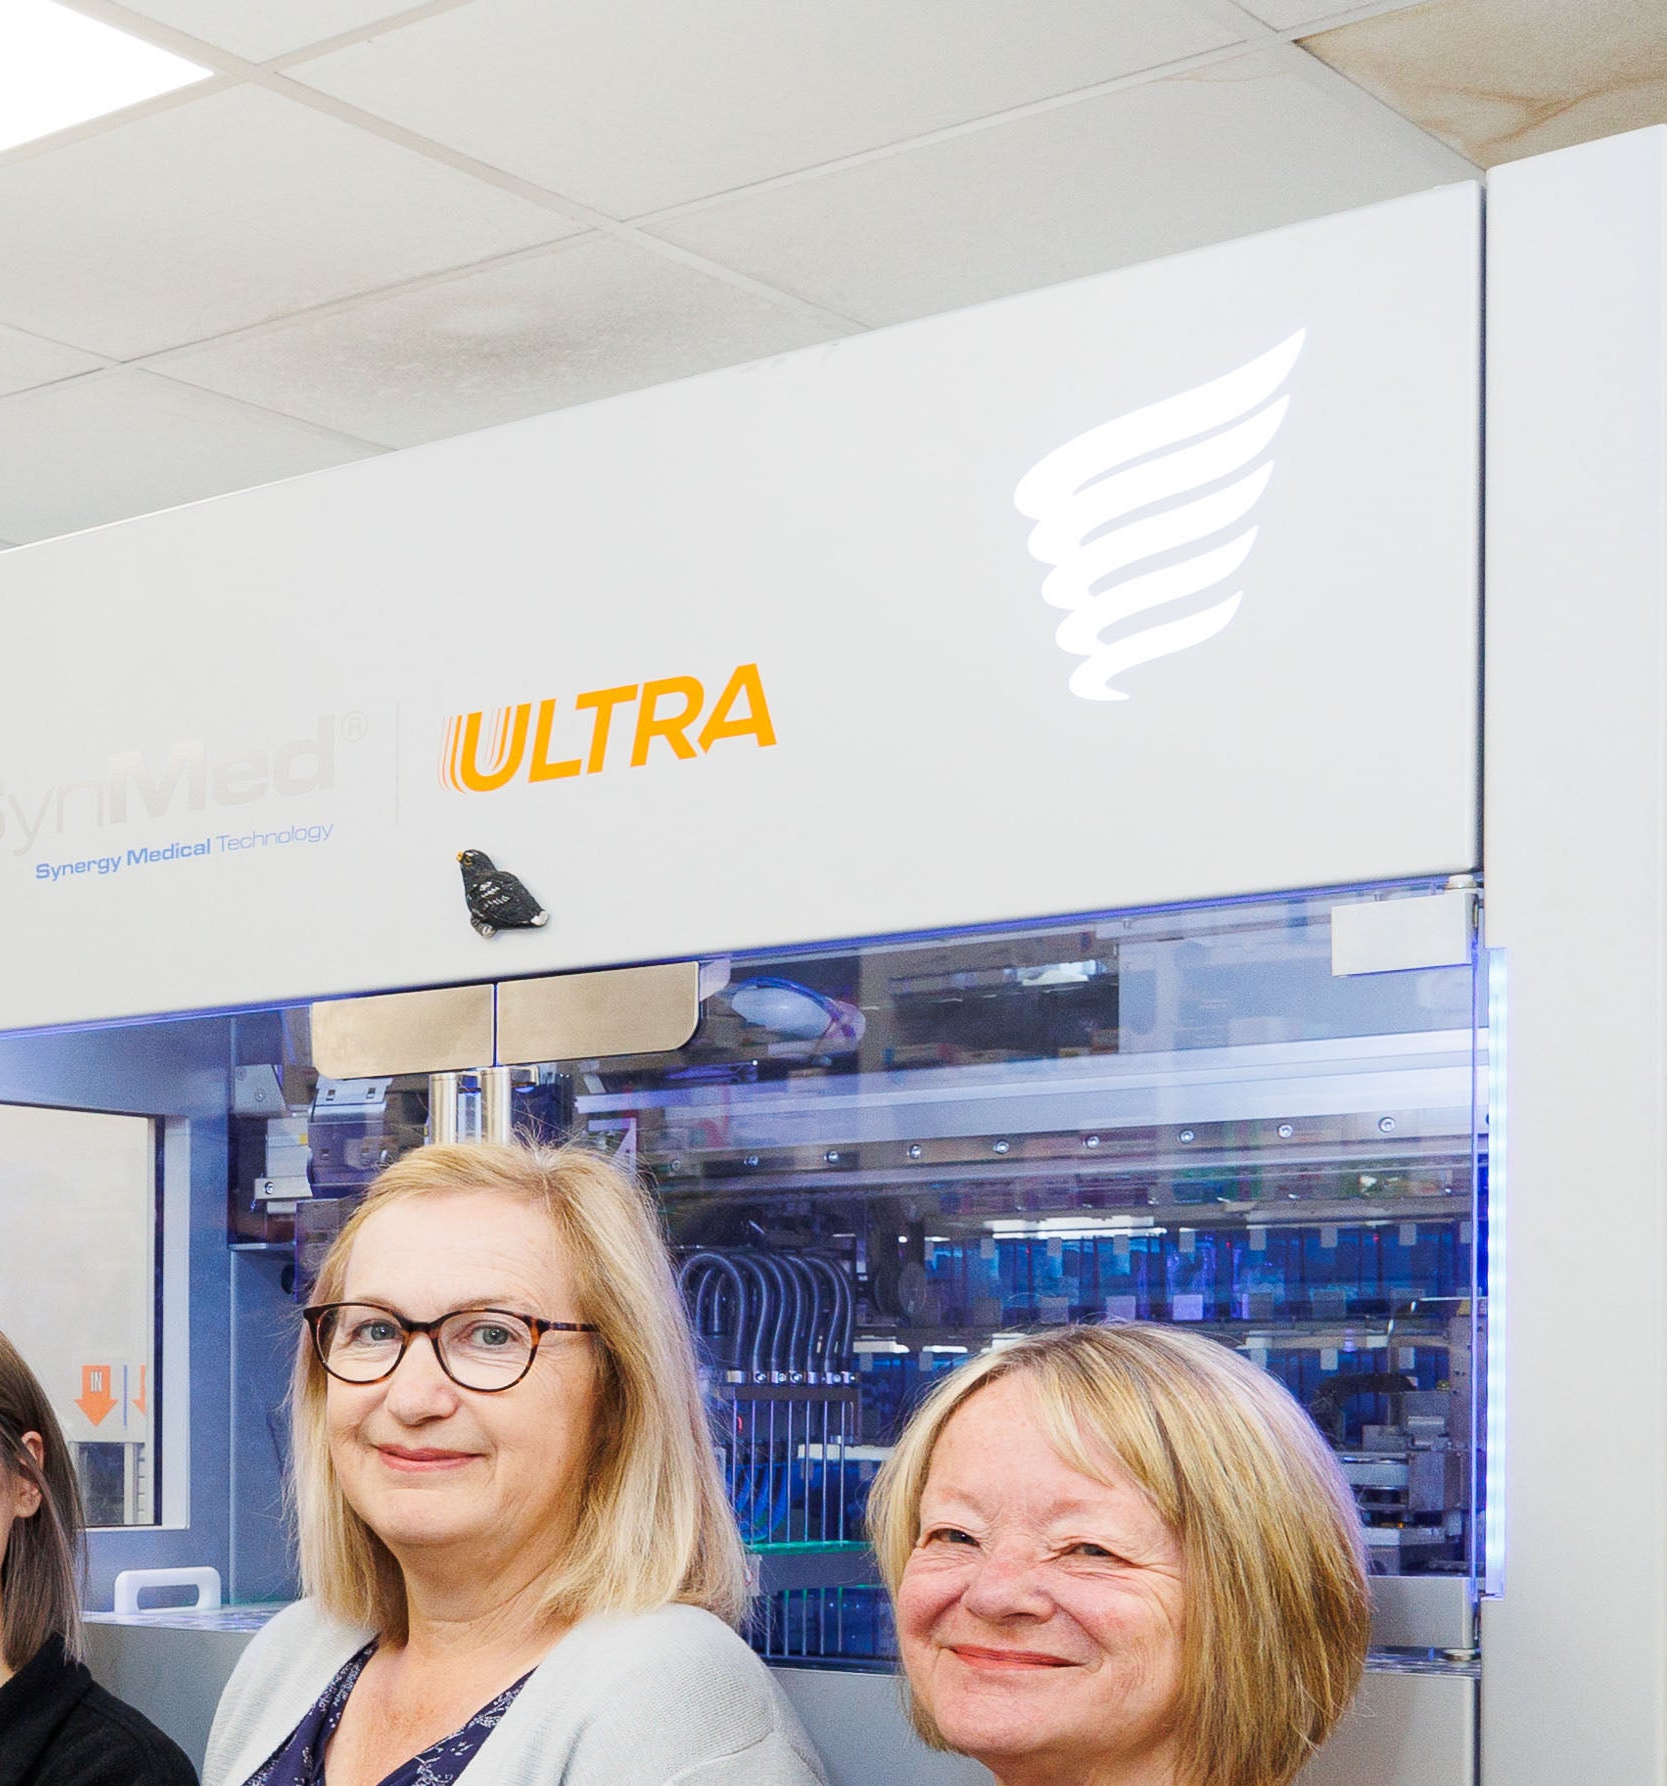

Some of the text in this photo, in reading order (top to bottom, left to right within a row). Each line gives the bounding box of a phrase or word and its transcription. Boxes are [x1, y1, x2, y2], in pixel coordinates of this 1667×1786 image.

[436, 662, 778, 793] ULTRA
[35, 824, 335, 882] Synergy Medical Technology
[90, 1371, 102, 1392] IN
